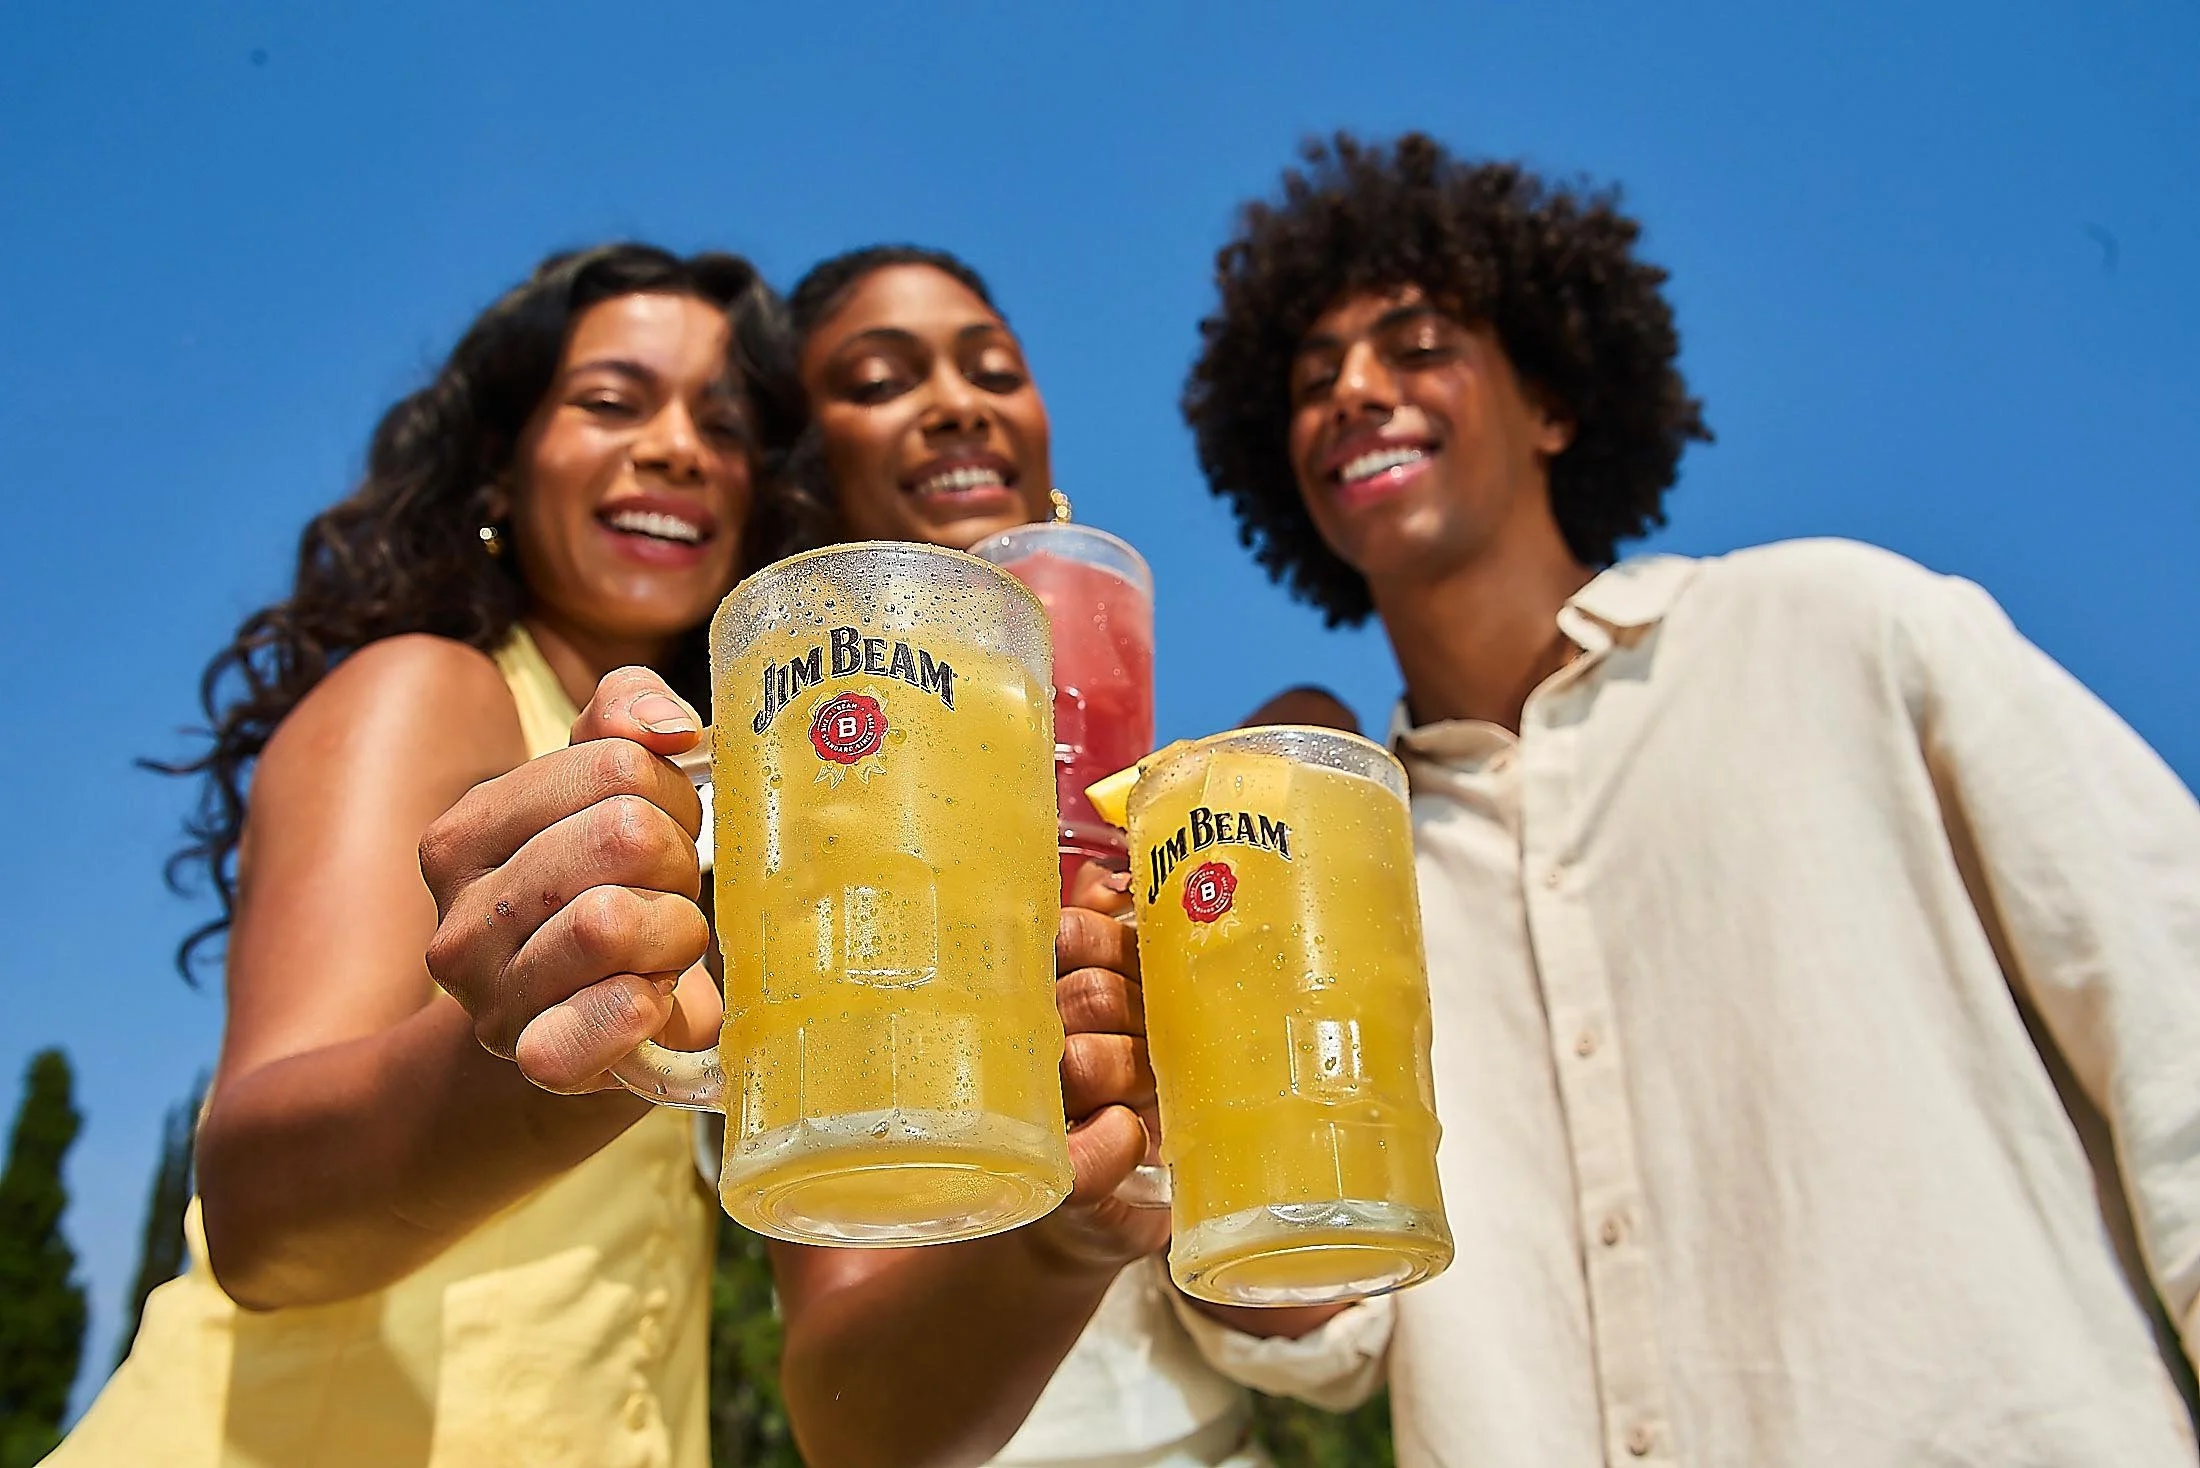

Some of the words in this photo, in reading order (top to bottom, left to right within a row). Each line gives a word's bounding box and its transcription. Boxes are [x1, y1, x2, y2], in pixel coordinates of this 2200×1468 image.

[752, 646, 825, 736] JIM
[830, 625, 955, 712] BEAM
[837, 717, 857, 738] B
[821, 734, 854, 753] STANDARD
[1148, 827, 1189, 905] JIM
[1190, 807, 1292, 861] BEAM
[1201, 881, 1216, 902] B
